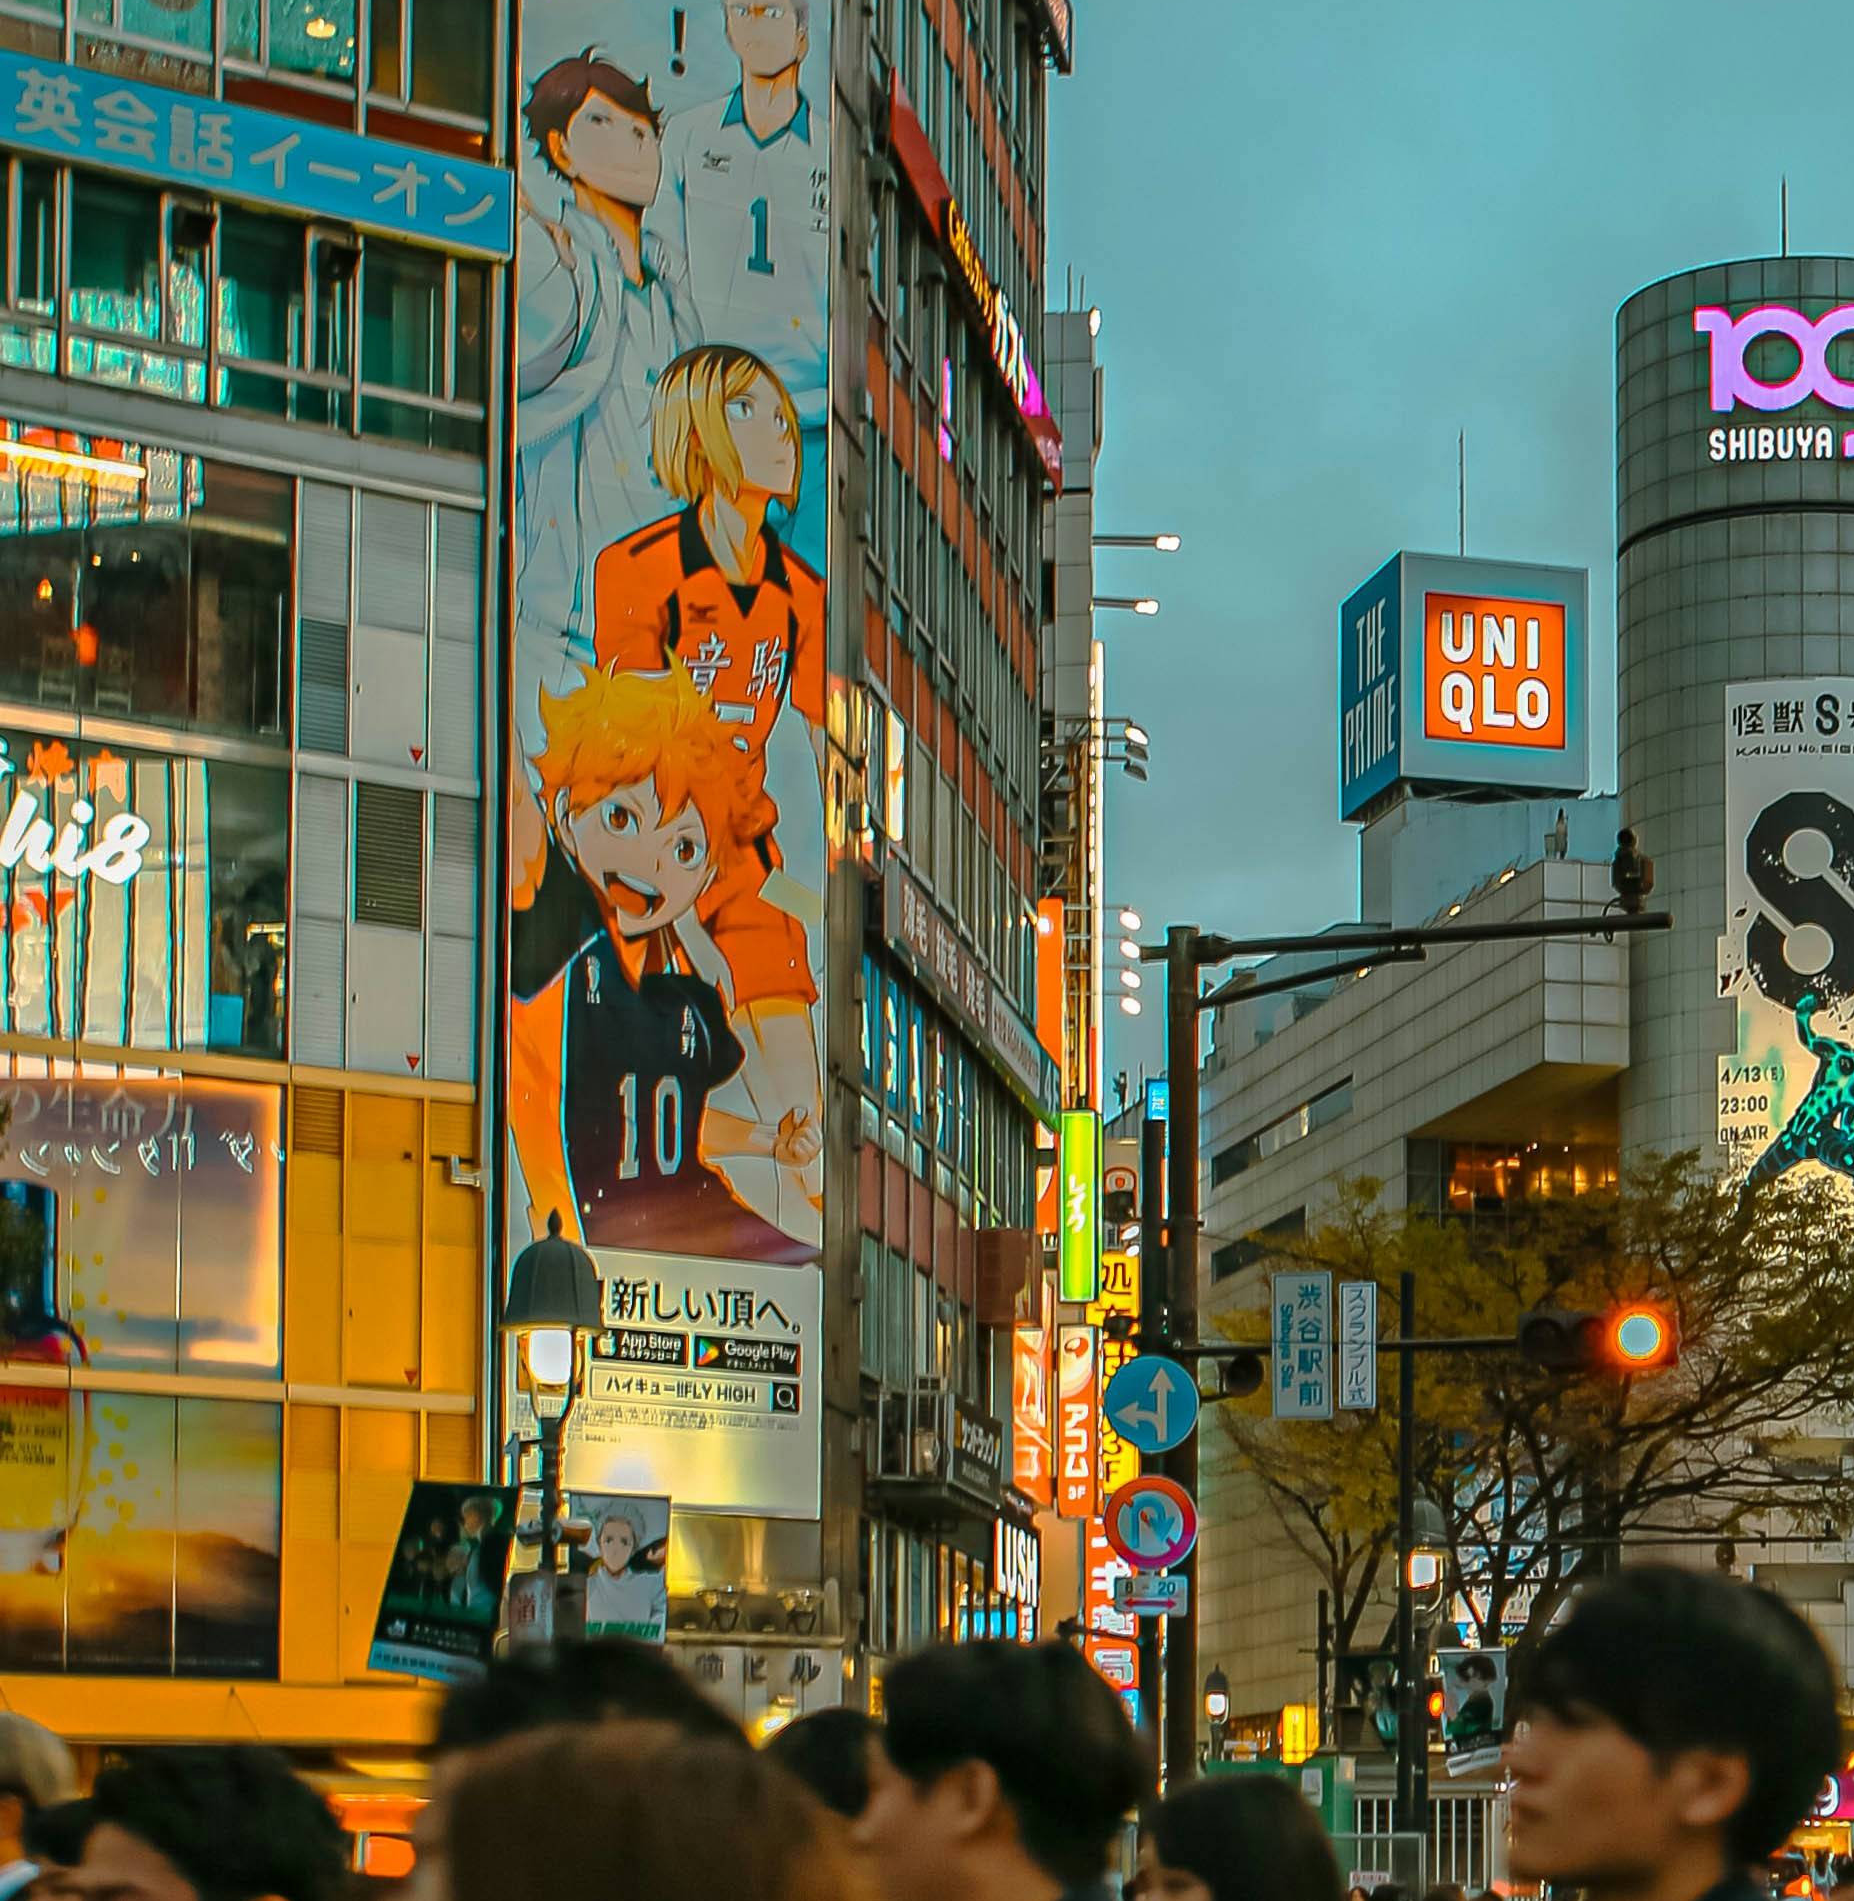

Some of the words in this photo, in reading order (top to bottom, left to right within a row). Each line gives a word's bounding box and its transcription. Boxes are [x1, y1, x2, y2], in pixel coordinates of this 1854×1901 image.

[13, 66, 496, 227] 英会話イーオン
[746, 197, 776, 276] 1
[1708, 425, 1834, 461] SHIBUYA
[1355, 597, 1386, 694] THE
[1440, 610, 1541, 671] UNI
[1343, 673, 1397, 788] PRIME
[1440, 670, 1551, 734] QLO
[1735, 743, 1792, 757] KAIJU
[616, 1071, 684, 1180] 10
[1719, 1094, 1769, 1116] 23:00
[609, 1277, 801, 1335] 新しい頂へ。
[620, 1332, 647, 1350] App
[648, 1333, 682, 1351] Store
[723, 1340, 770, 1361] Google
[770, 1344, 797, 1364] Play
[1297, 1282, 1324, 1407] 渋谷駅前
[715, 1384, 758, 1404] HIGH
[997, 1516, 1039, 1610] LUSH
[1158, 1580, 1176, 1595] 20
